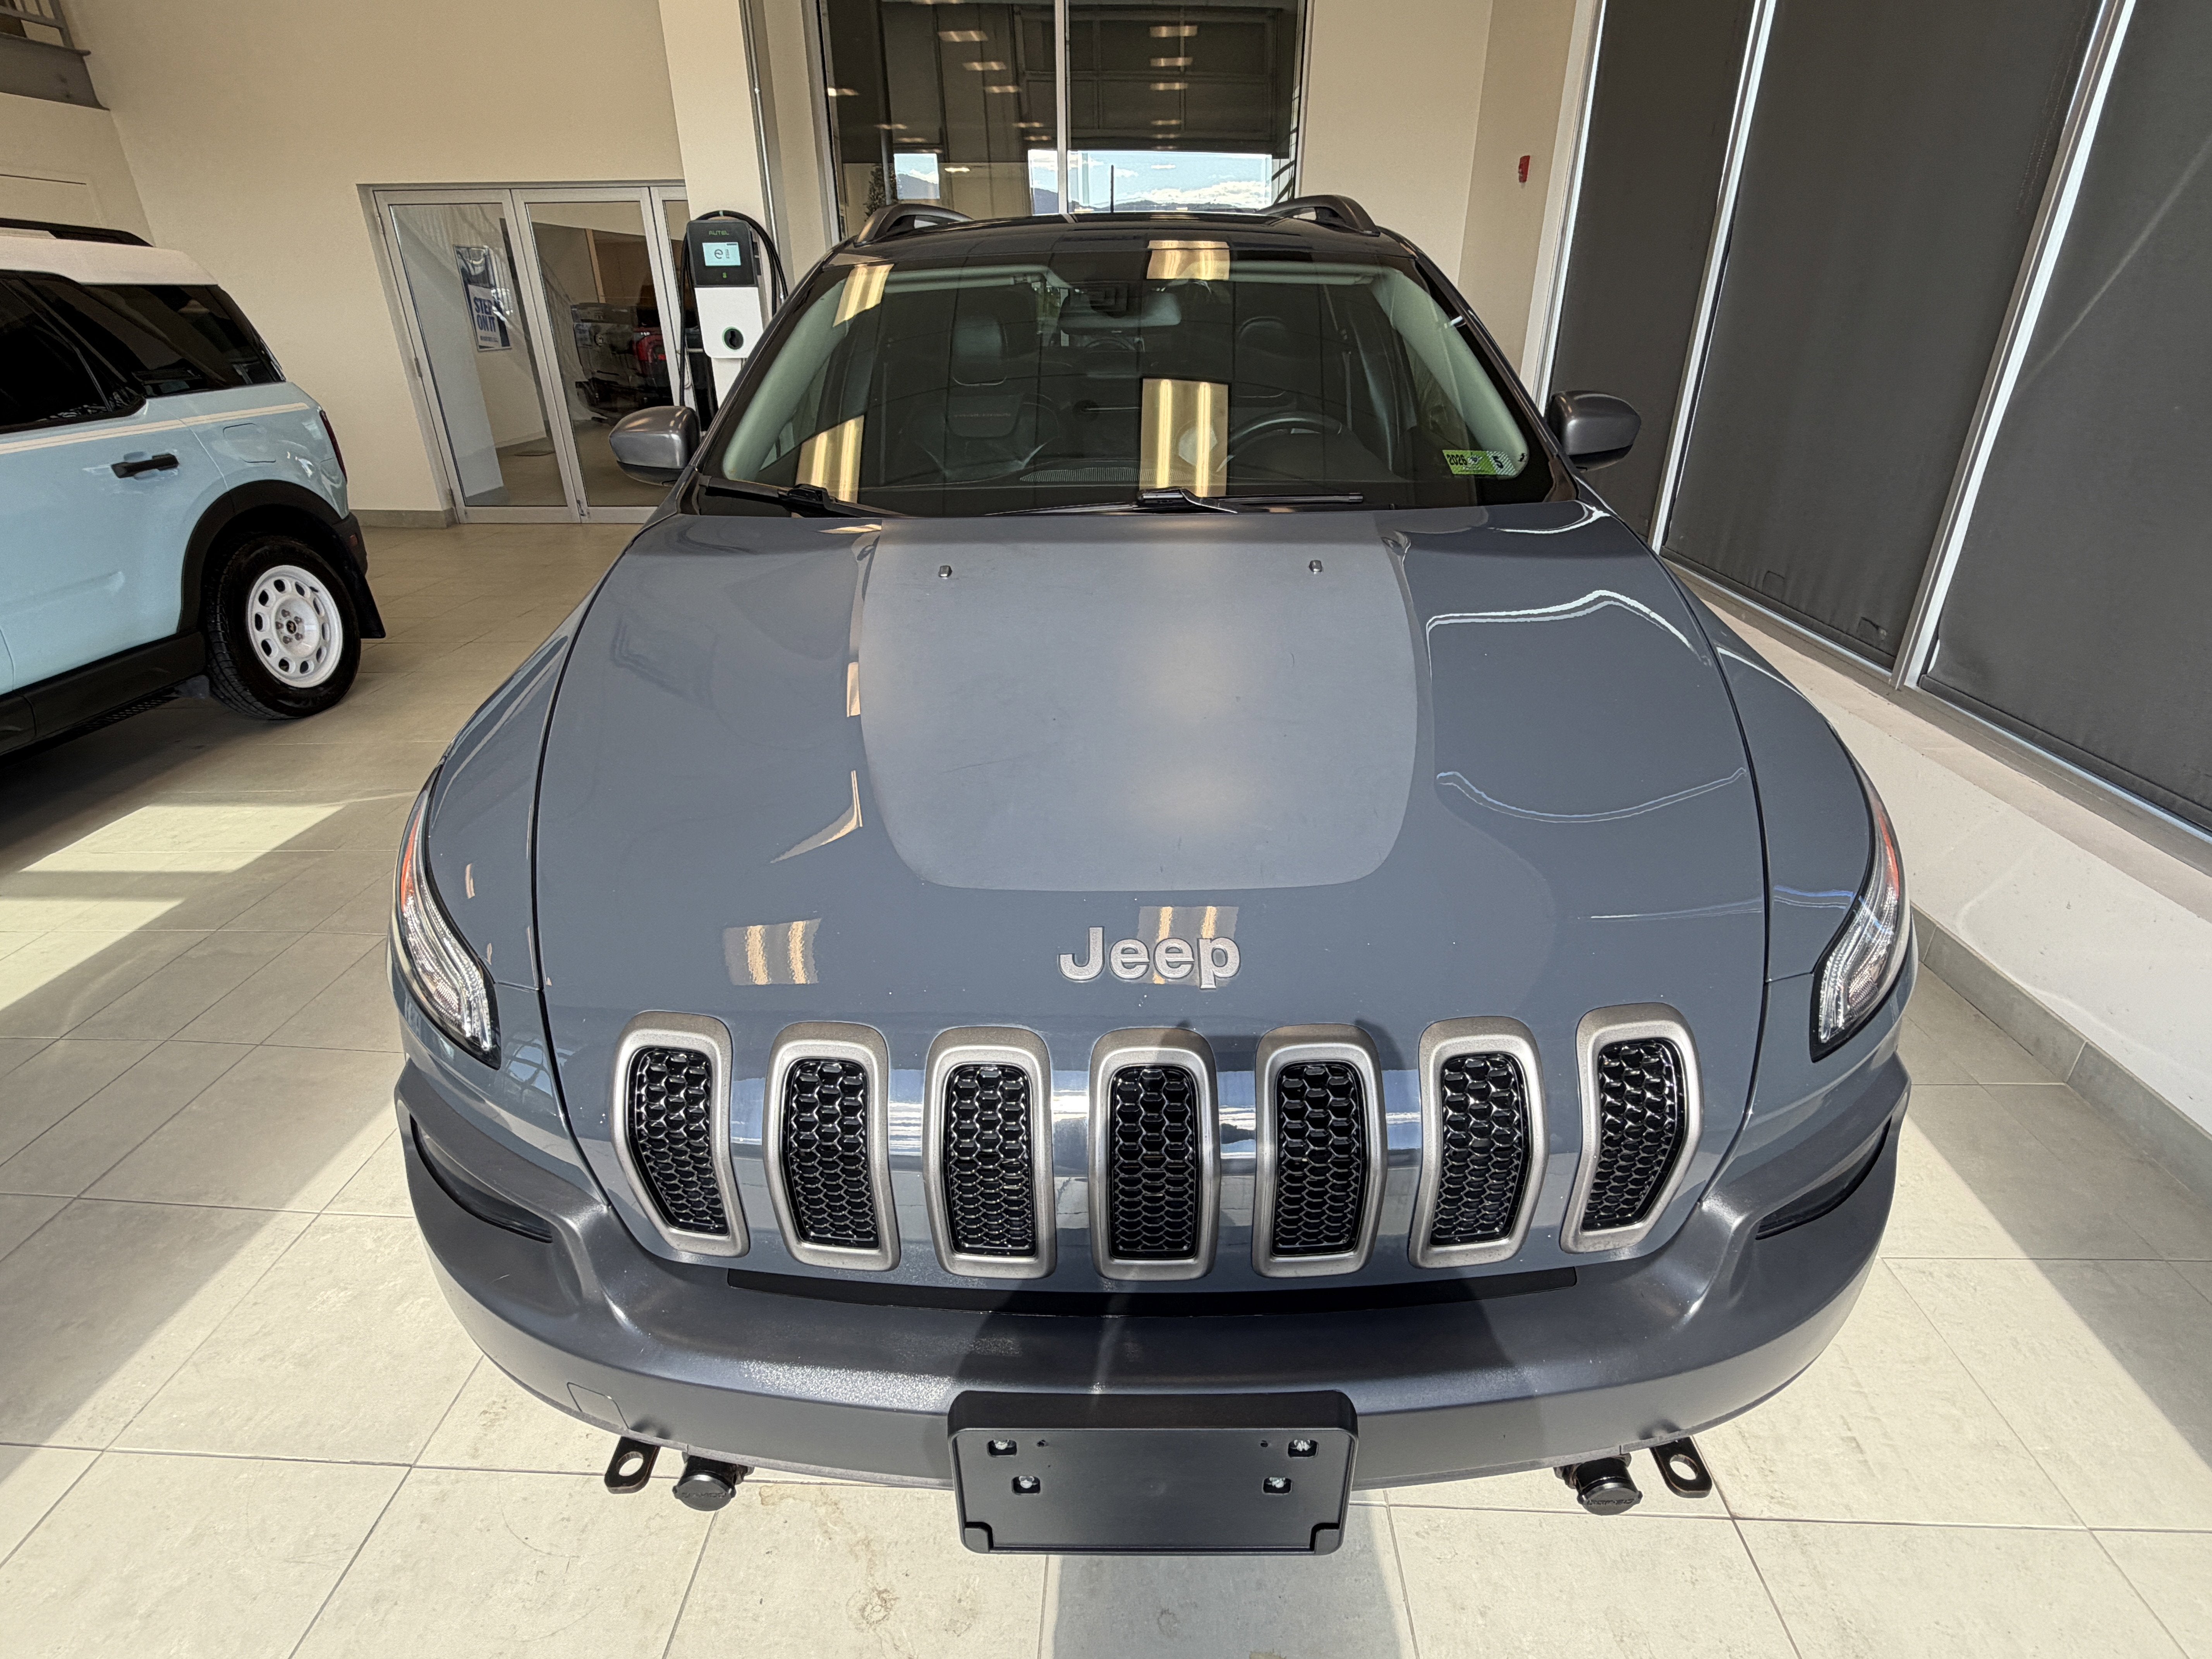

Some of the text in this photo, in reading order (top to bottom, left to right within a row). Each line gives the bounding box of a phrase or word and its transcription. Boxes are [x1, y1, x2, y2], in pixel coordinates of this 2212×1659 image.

[473, 297, 493, 315] STEP
[477, 314, 496, 333] ON IT
[1446, 454, 1468, 466] 2026
[1491, 455, 1504, 469] 5
[1057, 926, 1241, 990] Jeep
